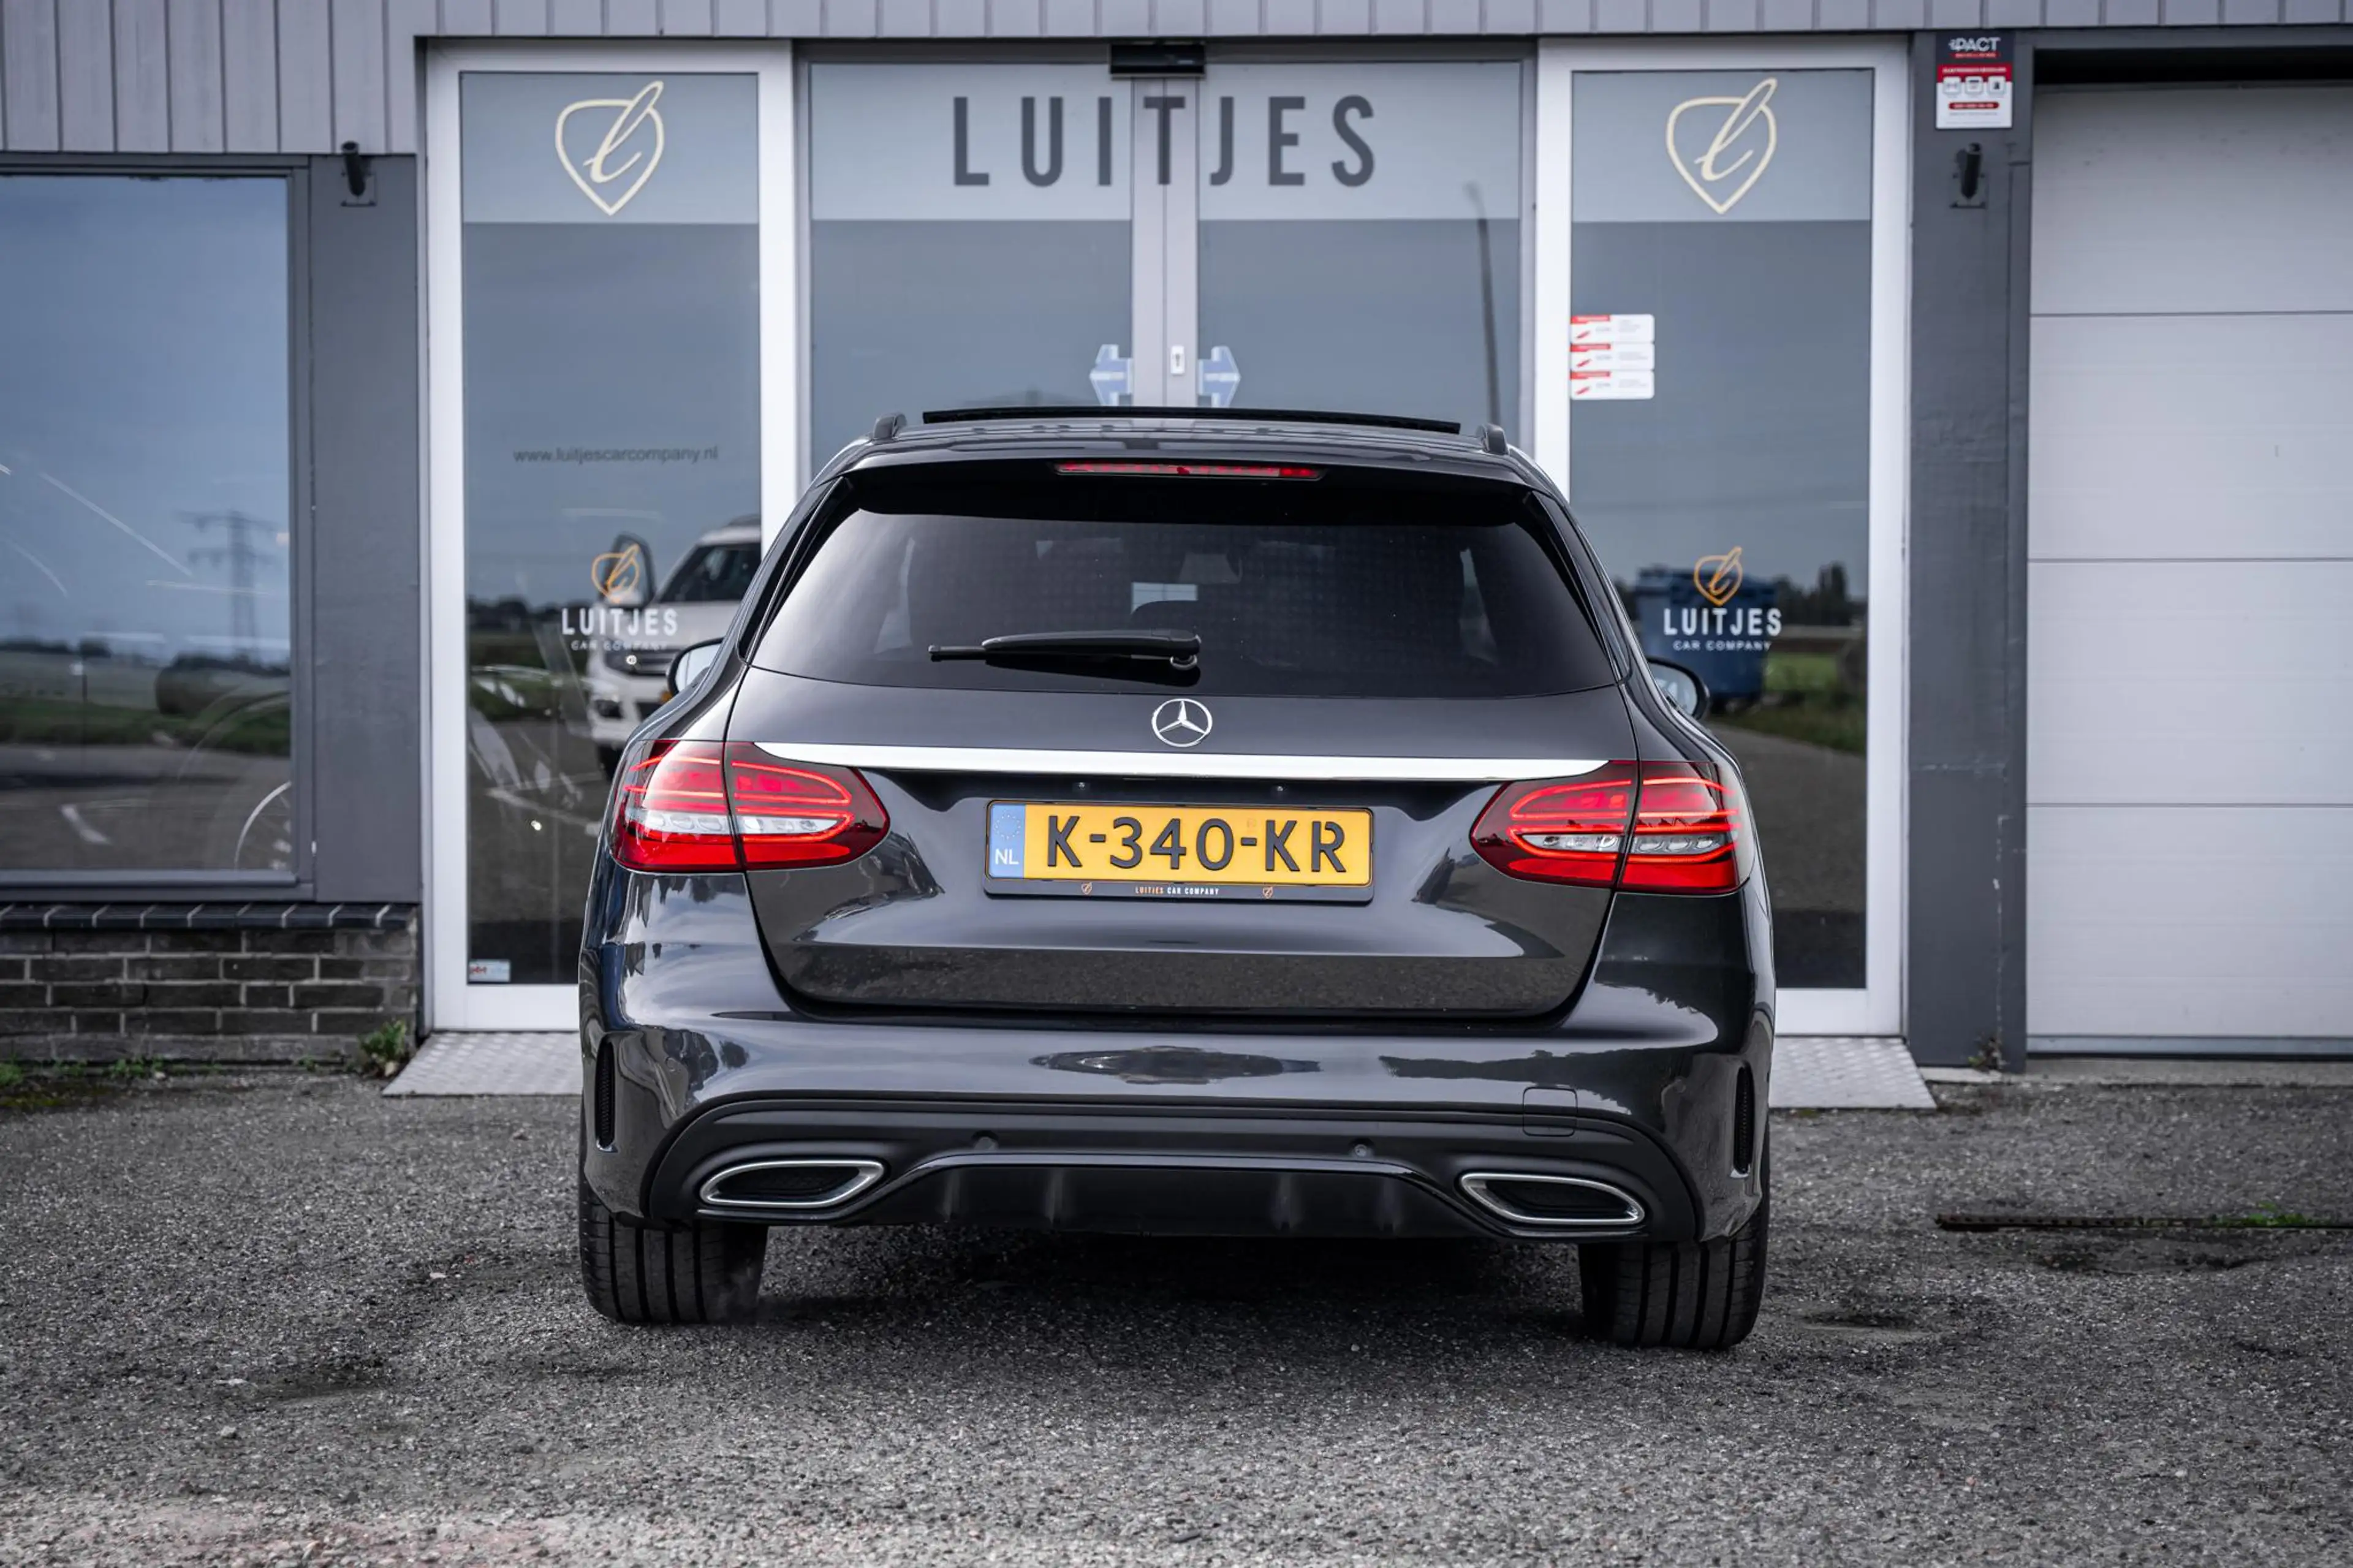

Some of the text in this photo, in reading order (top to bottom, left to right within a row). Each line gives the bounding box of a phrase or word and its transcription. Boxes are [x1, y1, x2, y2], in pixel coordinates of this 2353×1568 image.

[953, 94, 1374, 187] LUITJES
[513, 445, 718, 464] www.luitjescarcompany.nl
[562, 608, 678, 636] LUITJES
[1664, 607, 1782, 636] LUITJES
[1672, 640, 1773, 651] CAR COMPANY
[995, 848, 1018, 865] NL
[1047, 816, 1346, 873] K-340-KR
